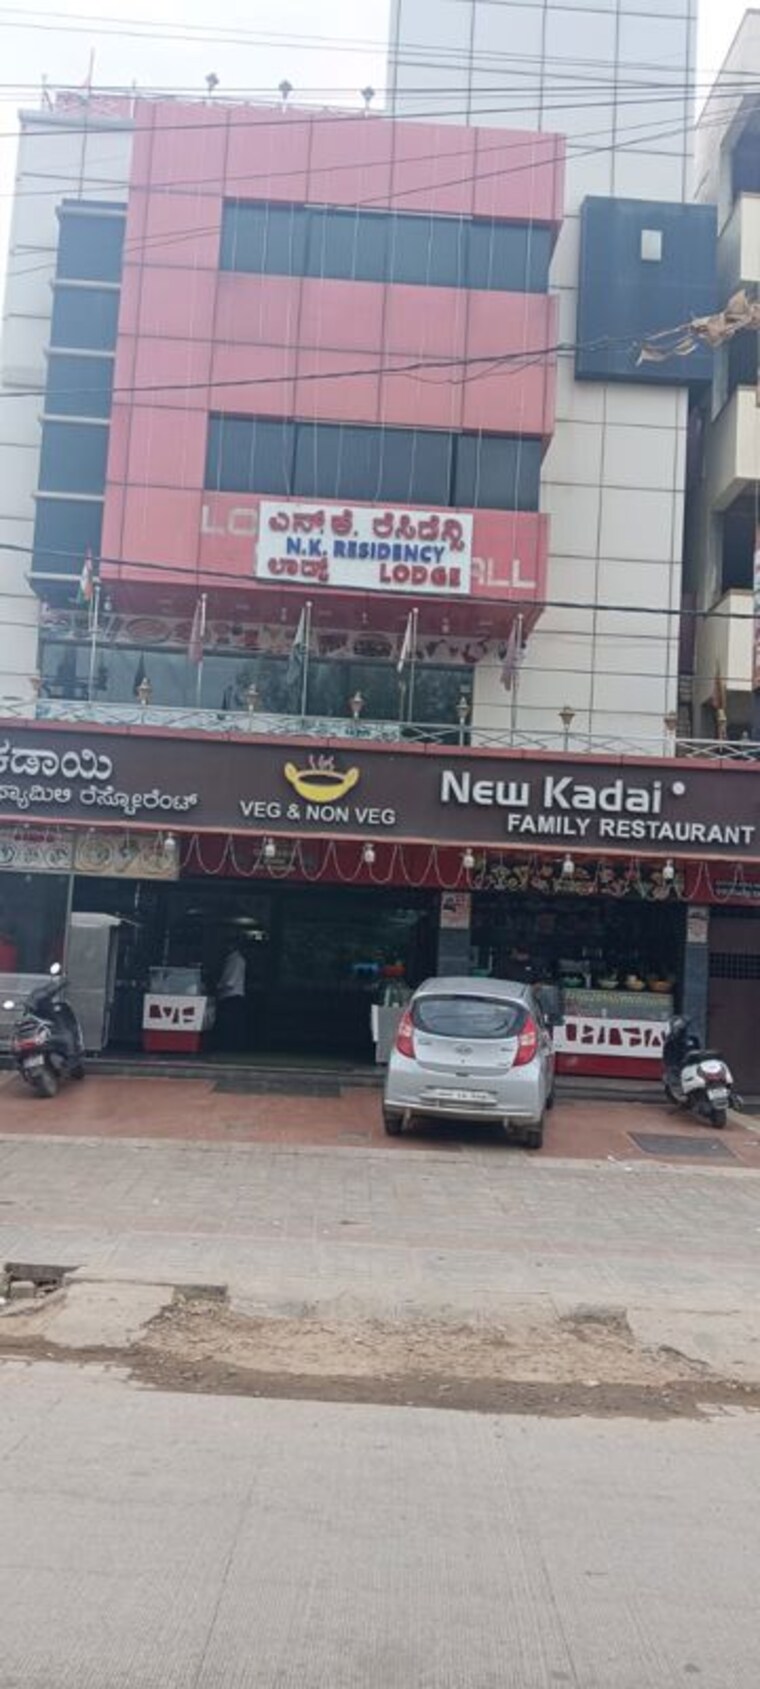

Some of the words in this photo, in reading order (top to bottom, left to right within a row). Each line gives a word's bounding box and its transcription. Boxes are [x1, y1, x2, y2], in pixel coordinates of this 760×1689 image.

[333, 540, 446, 564] RESIDENCY
[379, 562, 461, 588] LODGE
[440, 769, 529, 807] New
[543, 776, 662, 814] Kadai
[240, 801, 280, 819] VEG
[287, 803, 300, 819] &
[306, 804, 349, 822] NON
[355, 806, 396, 825] VEG
[508, 814, 590, 836] FAMILY
[599, 818, 755, 844] RESTAURANT
